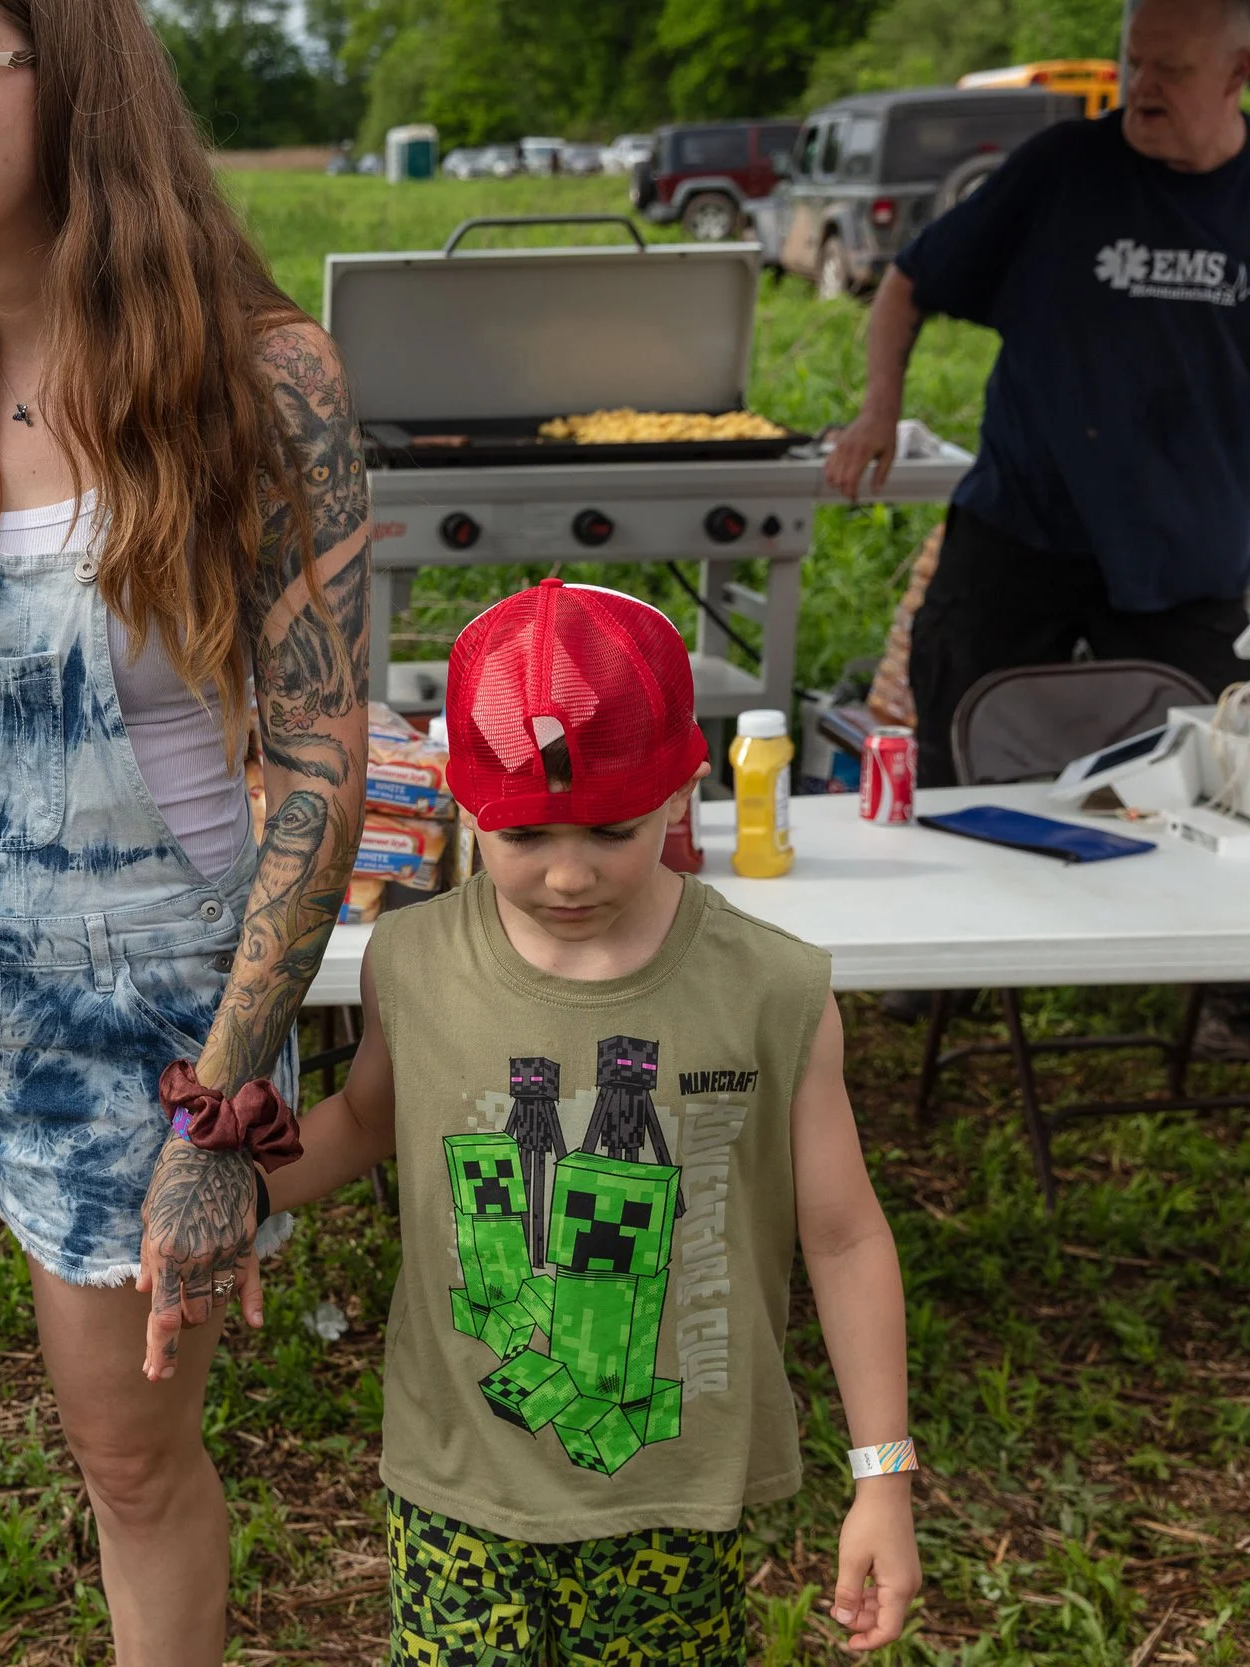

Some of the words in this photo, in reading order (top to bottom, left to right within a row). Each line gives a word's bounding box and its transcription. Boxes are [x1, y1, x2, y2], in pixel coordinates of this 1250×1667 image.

[1150, 249, 1227, 286] EMS
[678, 1070, 759, 1096] MINECRAFT
[677, 1094, 748, 1305] ADVENTURE
[676, 1307, 729, 1402] CLUB
